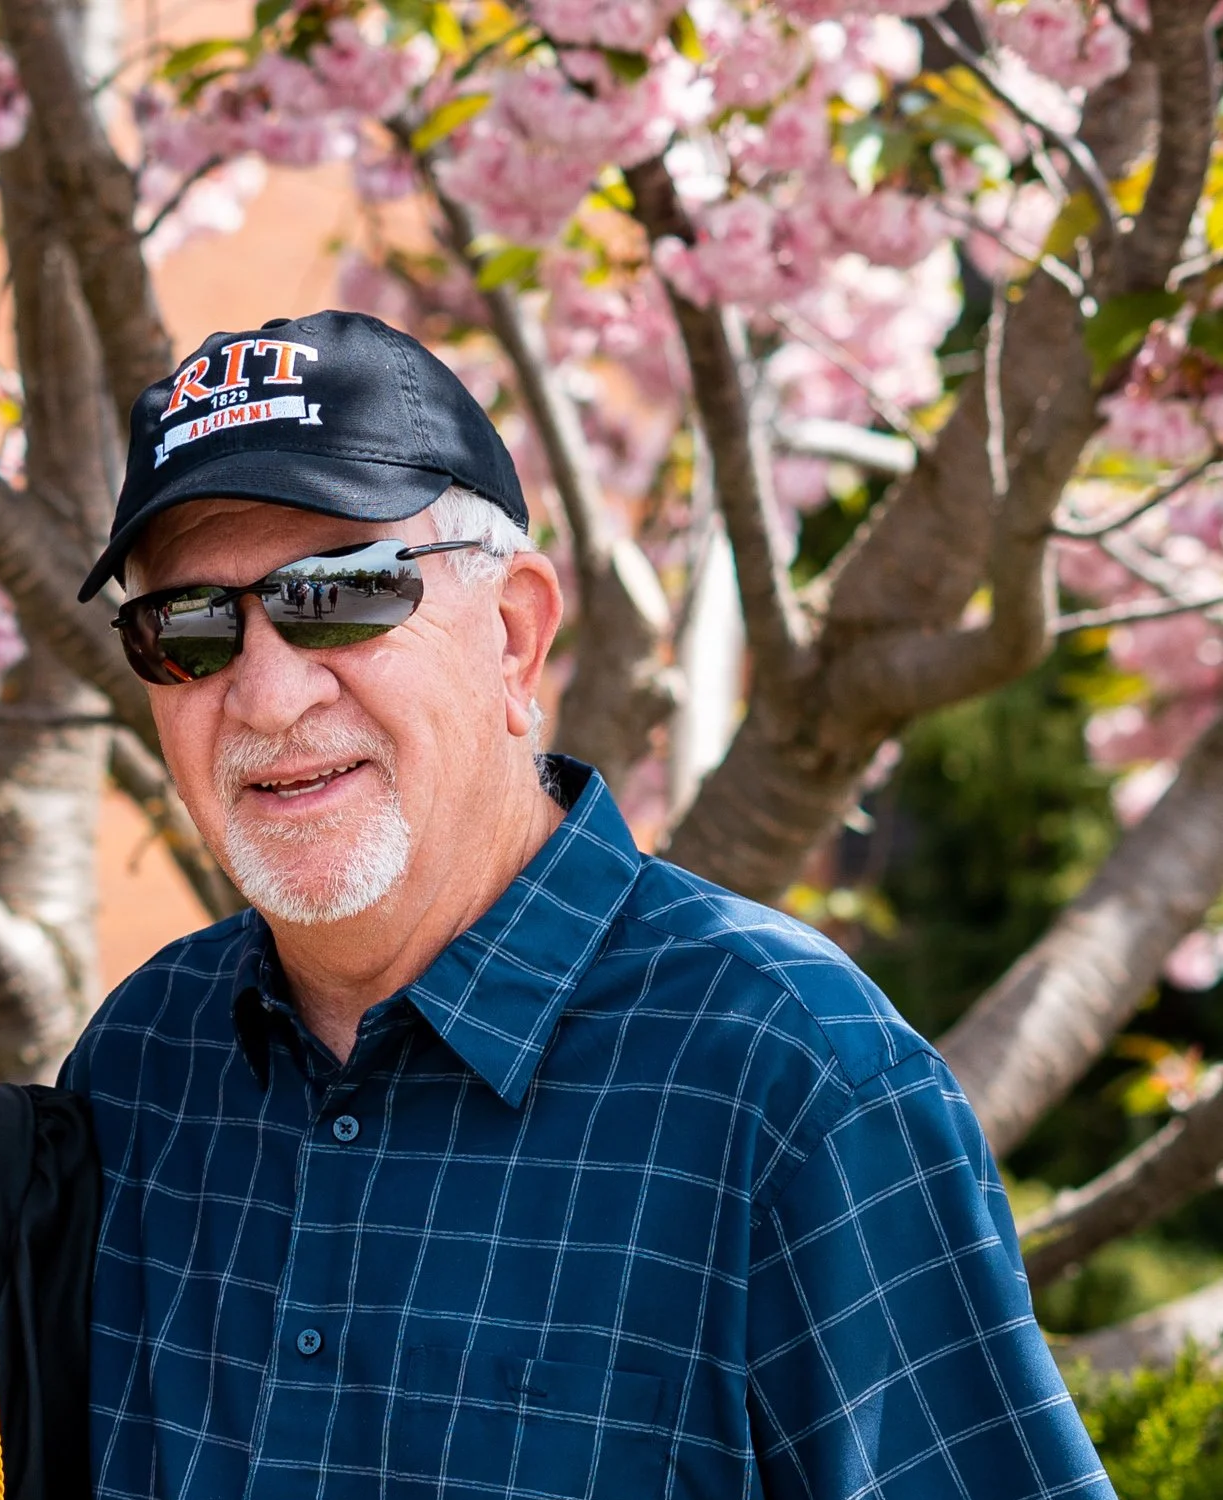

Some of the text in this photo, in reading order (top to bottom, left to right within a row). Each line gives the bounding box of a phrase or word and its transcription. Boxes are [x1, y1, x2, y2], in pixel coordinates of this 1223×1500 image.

[160, 338, 319, 422] RIT
[210, 389, 248, 408] 1829
[188, 401, 272, 439] ALUMNI
